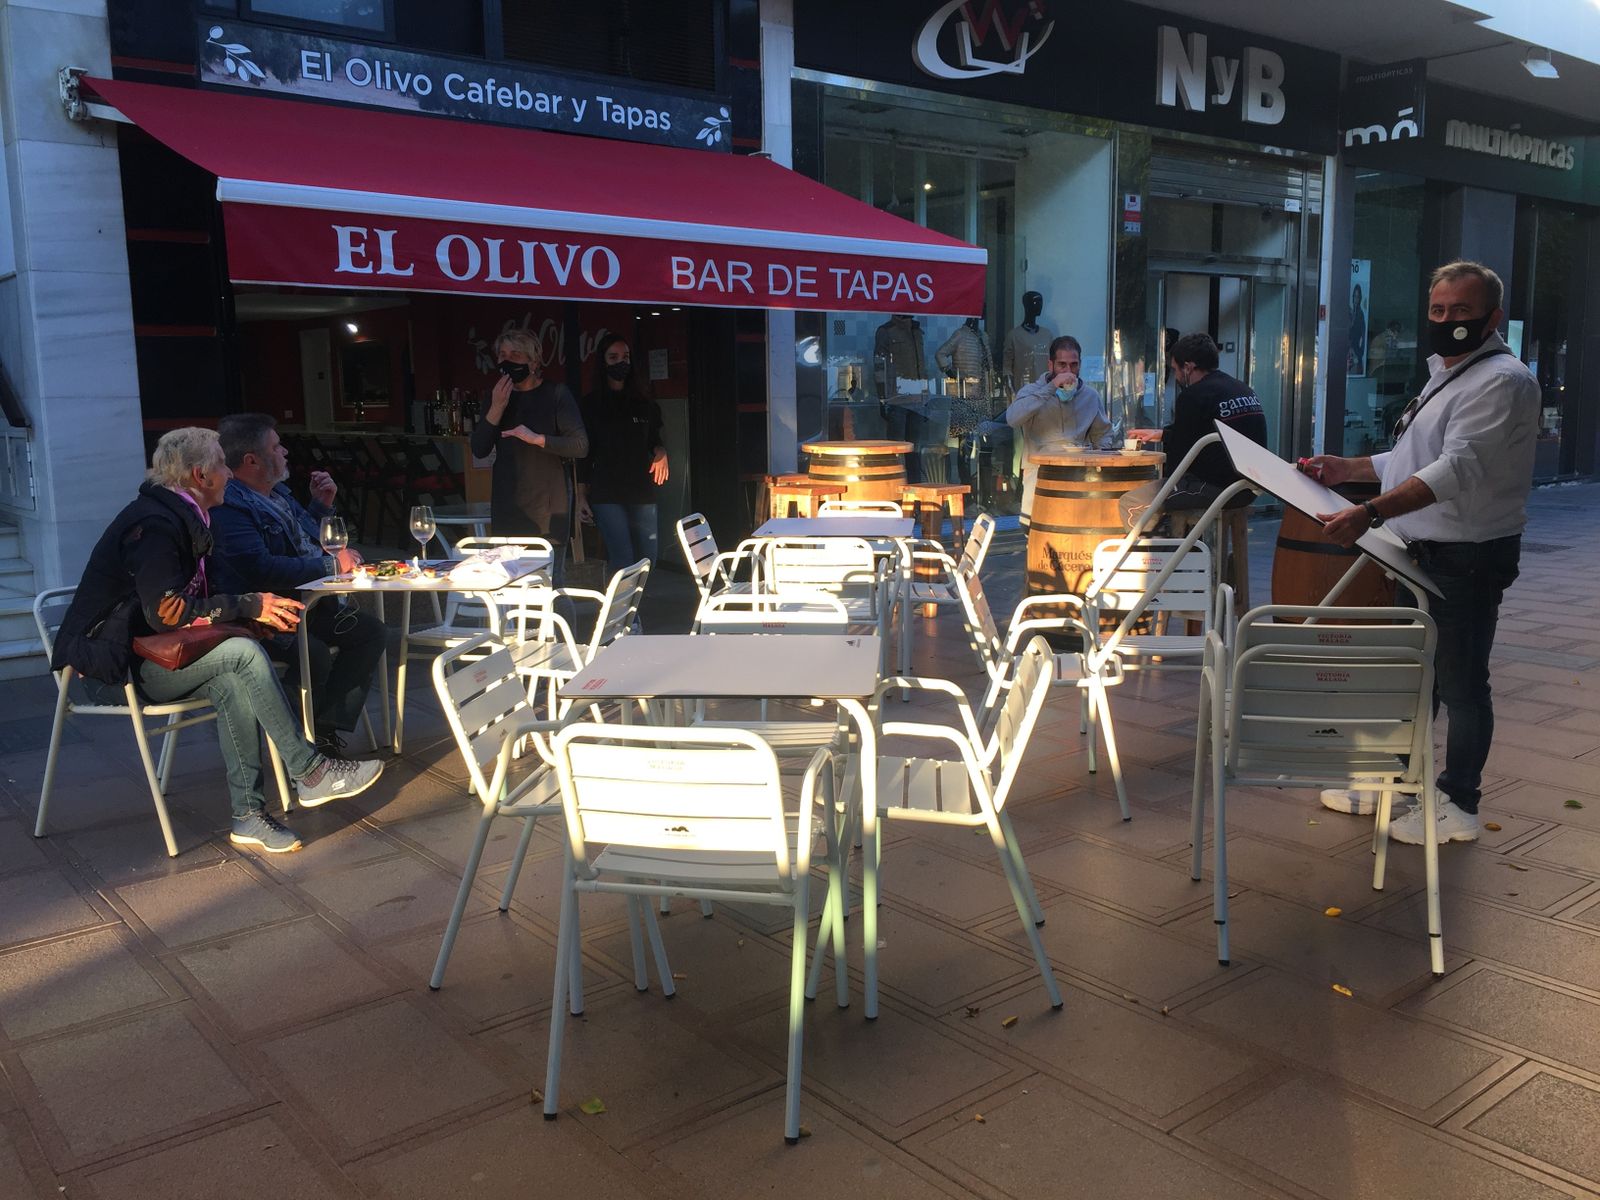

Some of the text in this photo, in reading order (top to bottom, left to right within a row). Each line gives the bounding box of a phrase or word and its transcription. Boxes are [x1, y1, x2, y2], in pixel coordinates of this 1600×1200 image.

[300, 49, 671, 131] El Olivo Cafebar y Tapas
[1156, 25, 1286, 127] NyB
[332, 224, 621, 290] EL OLIVO
[670, 255, 934, 304] BAR DE TAPAS
